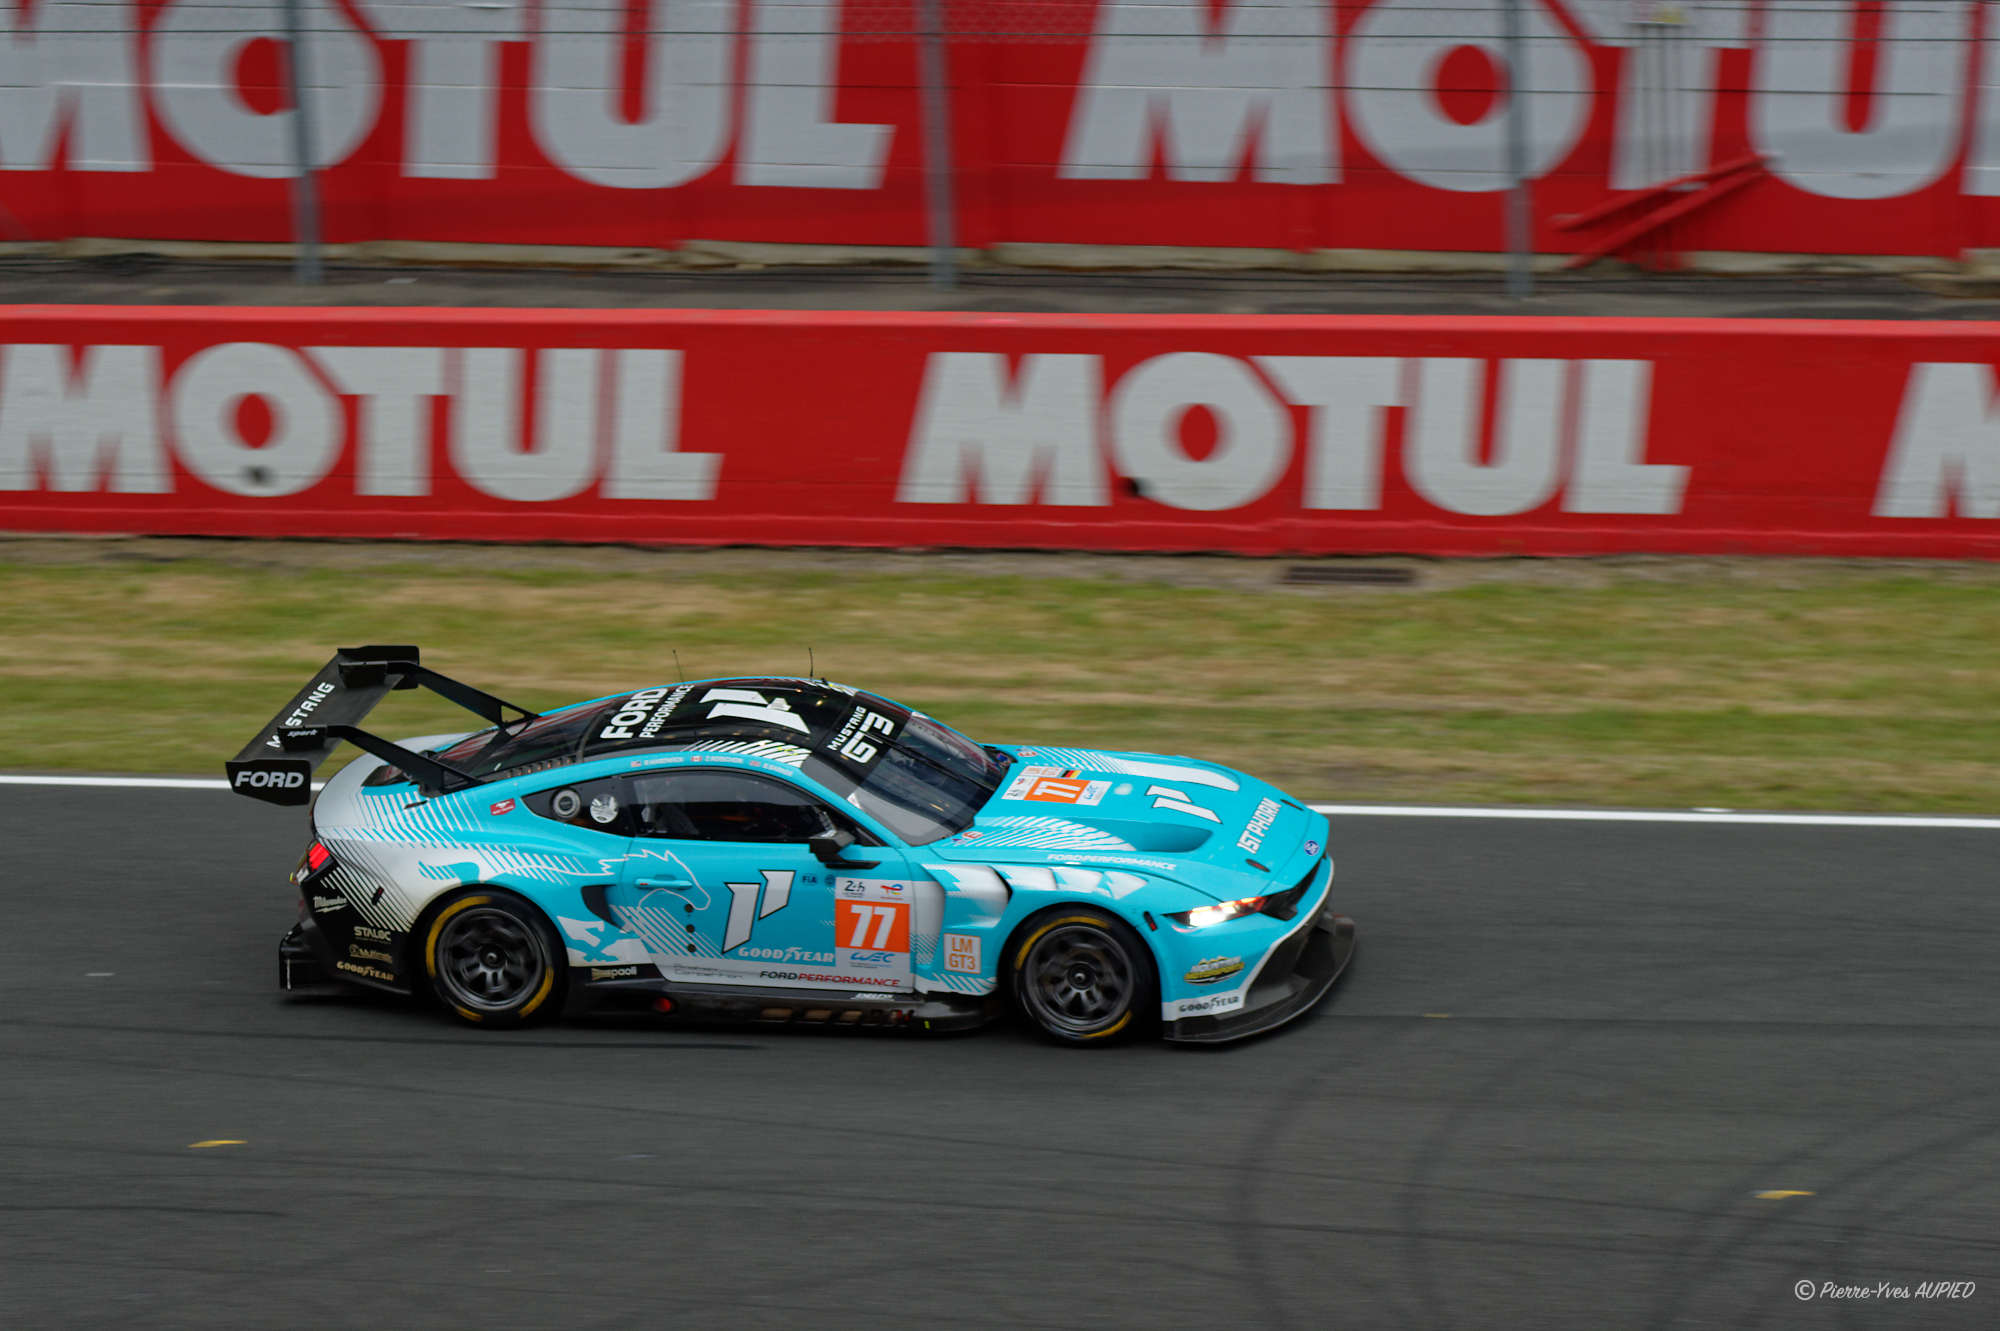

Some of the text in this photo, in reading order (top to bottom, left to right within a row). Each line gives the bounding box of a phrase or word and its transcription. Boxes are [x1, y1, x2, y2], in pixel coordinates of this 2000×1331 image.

[0, 341, 723, 501] MOTUL
[895, 351, 1691, 517] MOTUL
[266, 682, 335, 748] MSTANG
[600, 687, 668, 739] FORD
[639, 684, 695, 738] PERFORMANCE
[827, 706, 867, 750] MUSTANG
[234, 771, 304, 788] FORD
[849, 904, 897, 949] 77
[951, 937, 973, 953] LM
[738, 946, 835, 963] GOODYEAR
[850, 952, 896, 963] WEC
[948, 954, 975, 970] GT3
